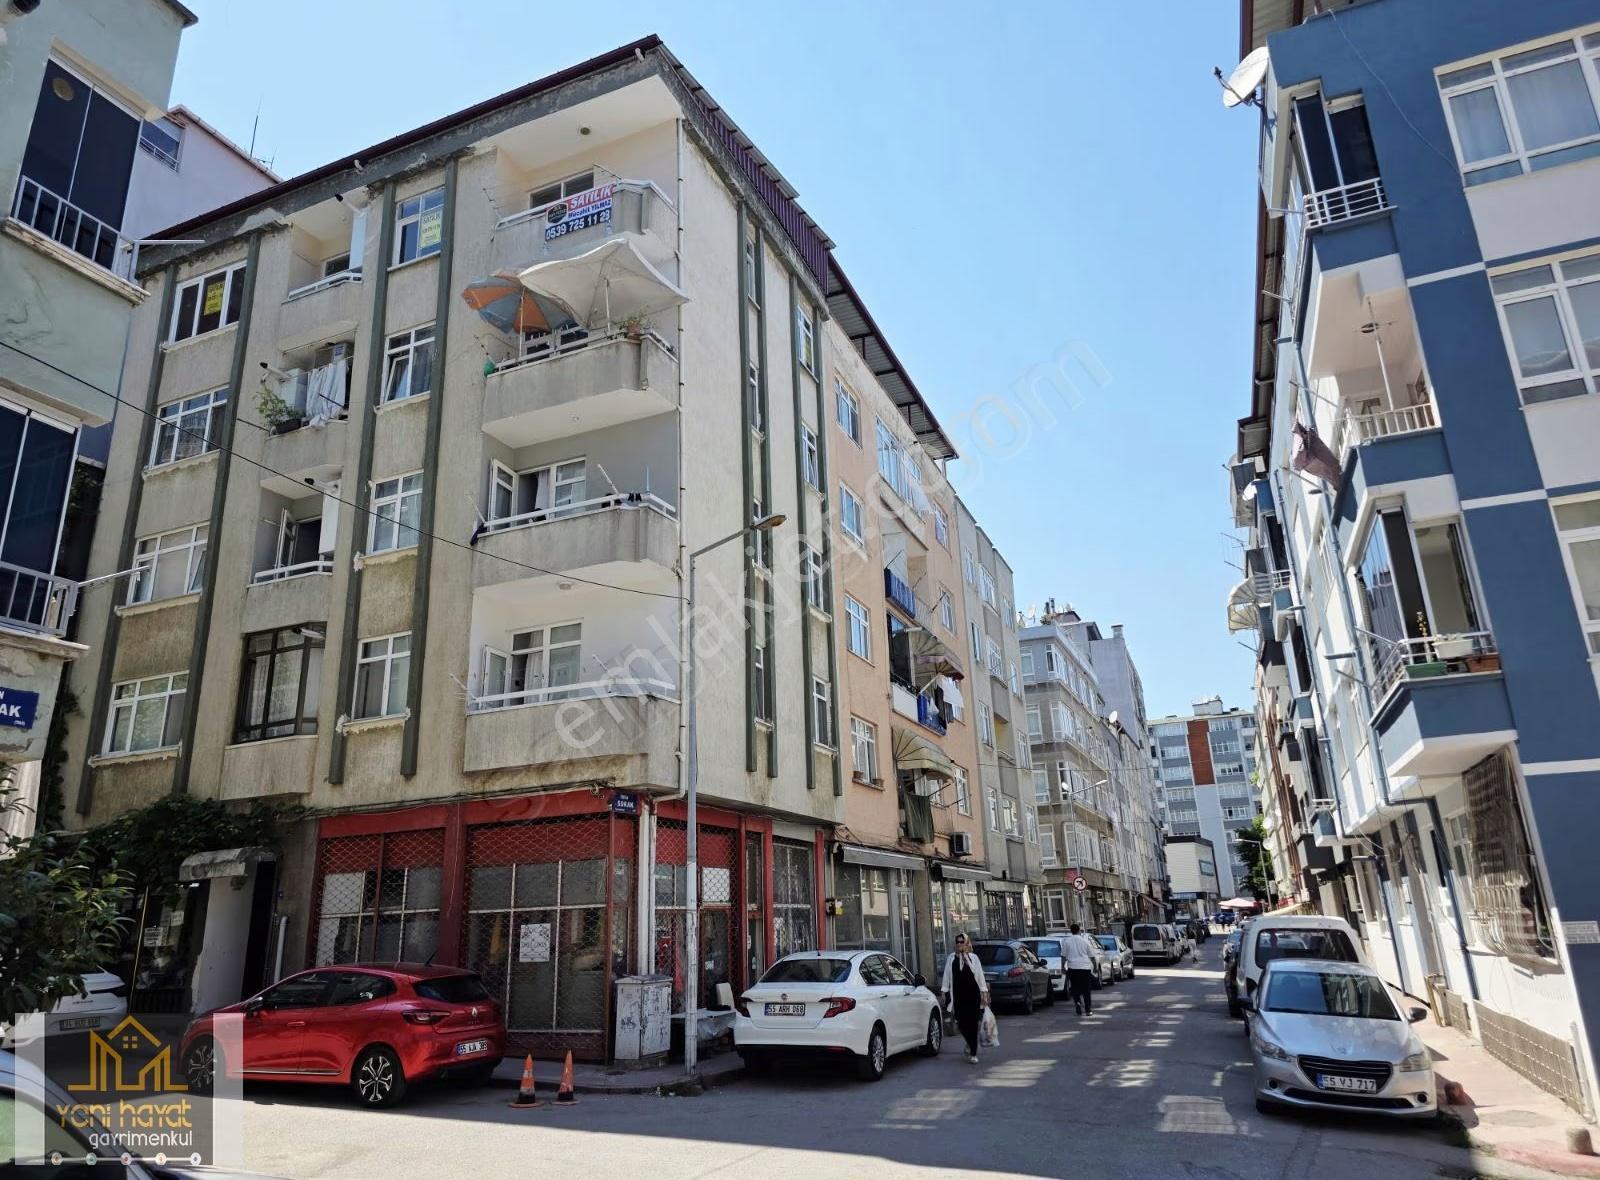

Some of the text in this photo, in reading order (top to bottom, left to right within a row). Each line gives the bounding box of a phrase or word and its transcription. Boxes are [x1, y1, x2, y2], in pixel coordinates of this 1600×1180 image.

[570, 185, 613, 208] SATILIK
[546, 223, 567, 240] 0539
[569, 217, 585, 231] 725
[588, 214, 598, 226] 11
[1322, 1076, 1375, 1090] 55 VJ 717
